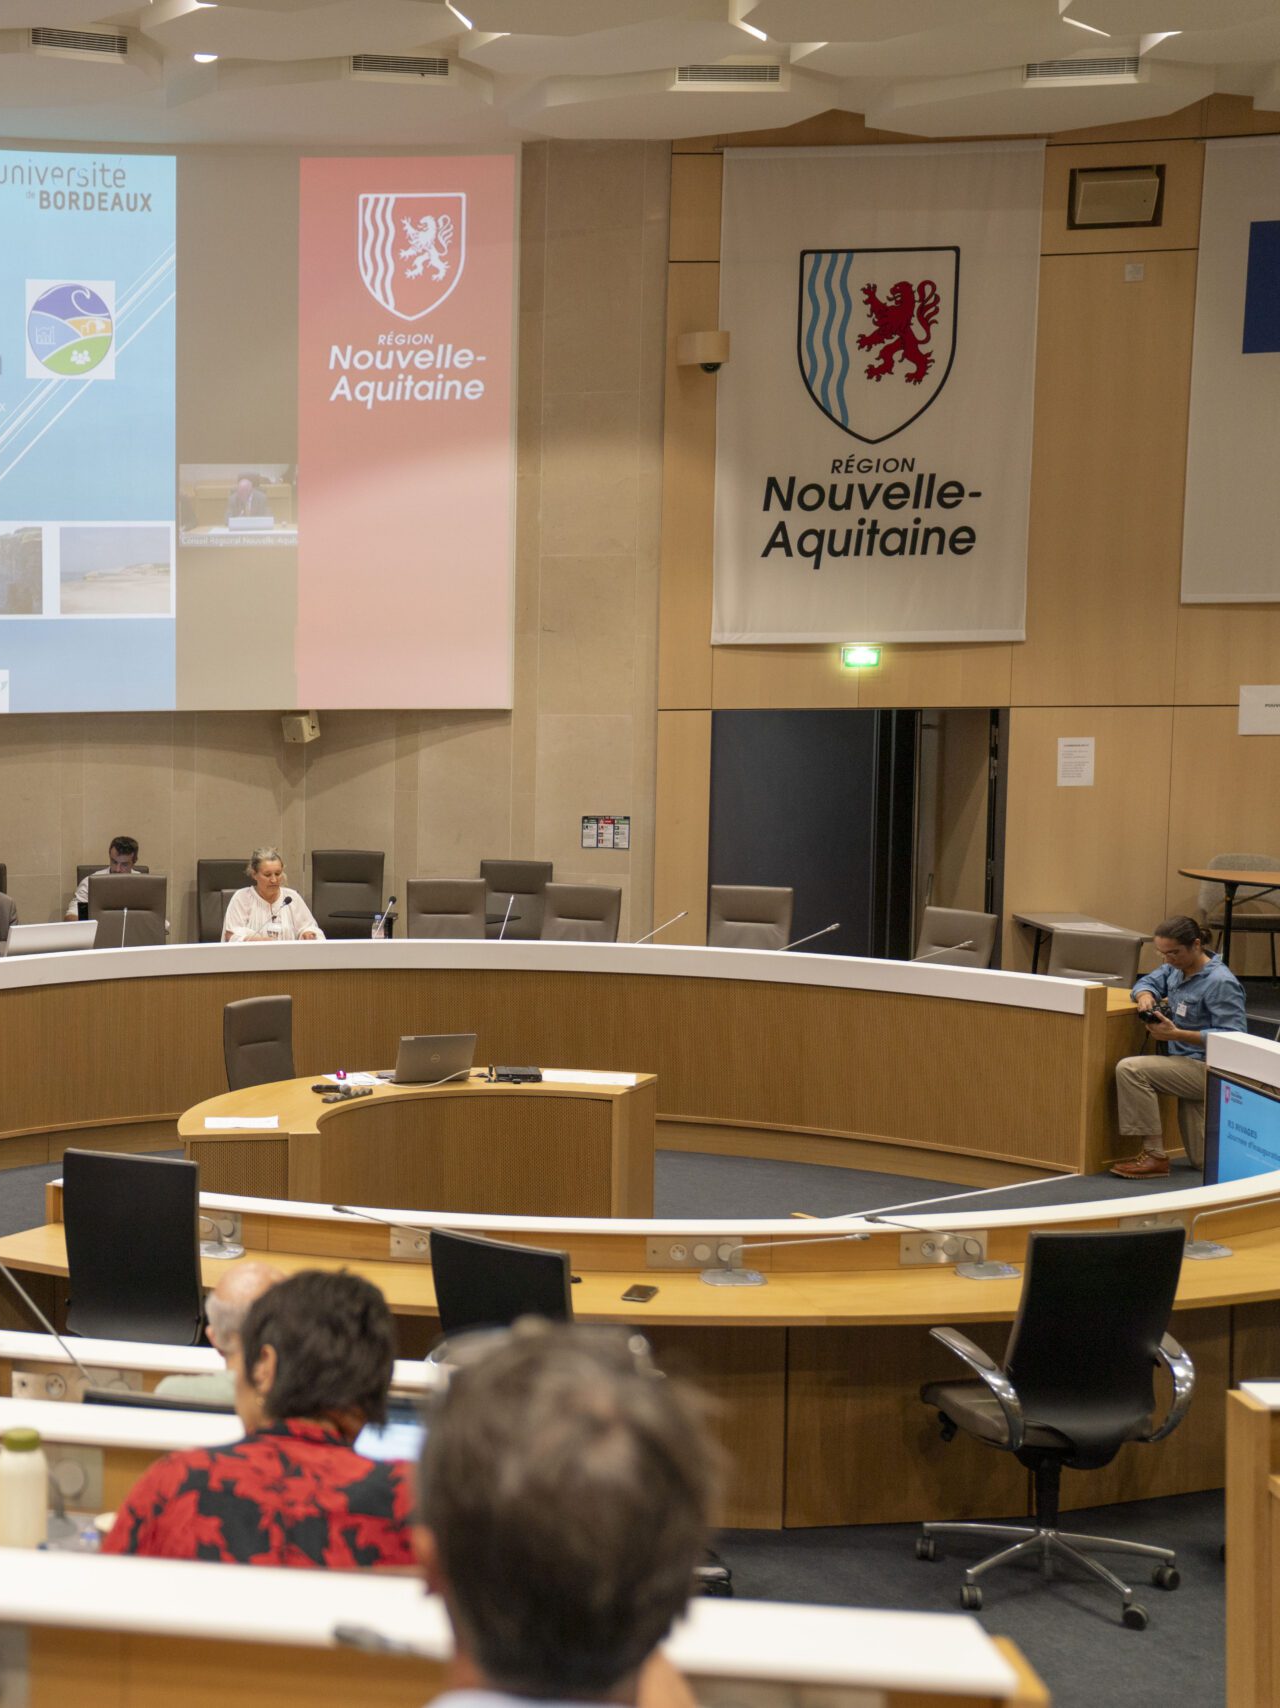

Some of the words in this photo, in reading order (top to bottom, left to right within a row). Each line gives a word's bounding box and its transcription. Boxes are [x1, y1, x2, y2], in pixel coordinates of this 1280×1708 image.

[39, 190, 152, 212] BORDEAUX
[377, 330, 435, 346] RÉGION
[328, 343, 487, 371] Nouvelle-
[329, 373, 485, 410] Aquitaine
[830, 453, 916, 474] RÉGION
[762, 472, 983, 512] Nouvelle-
[760, 516, 977, 570] Aquitaine
